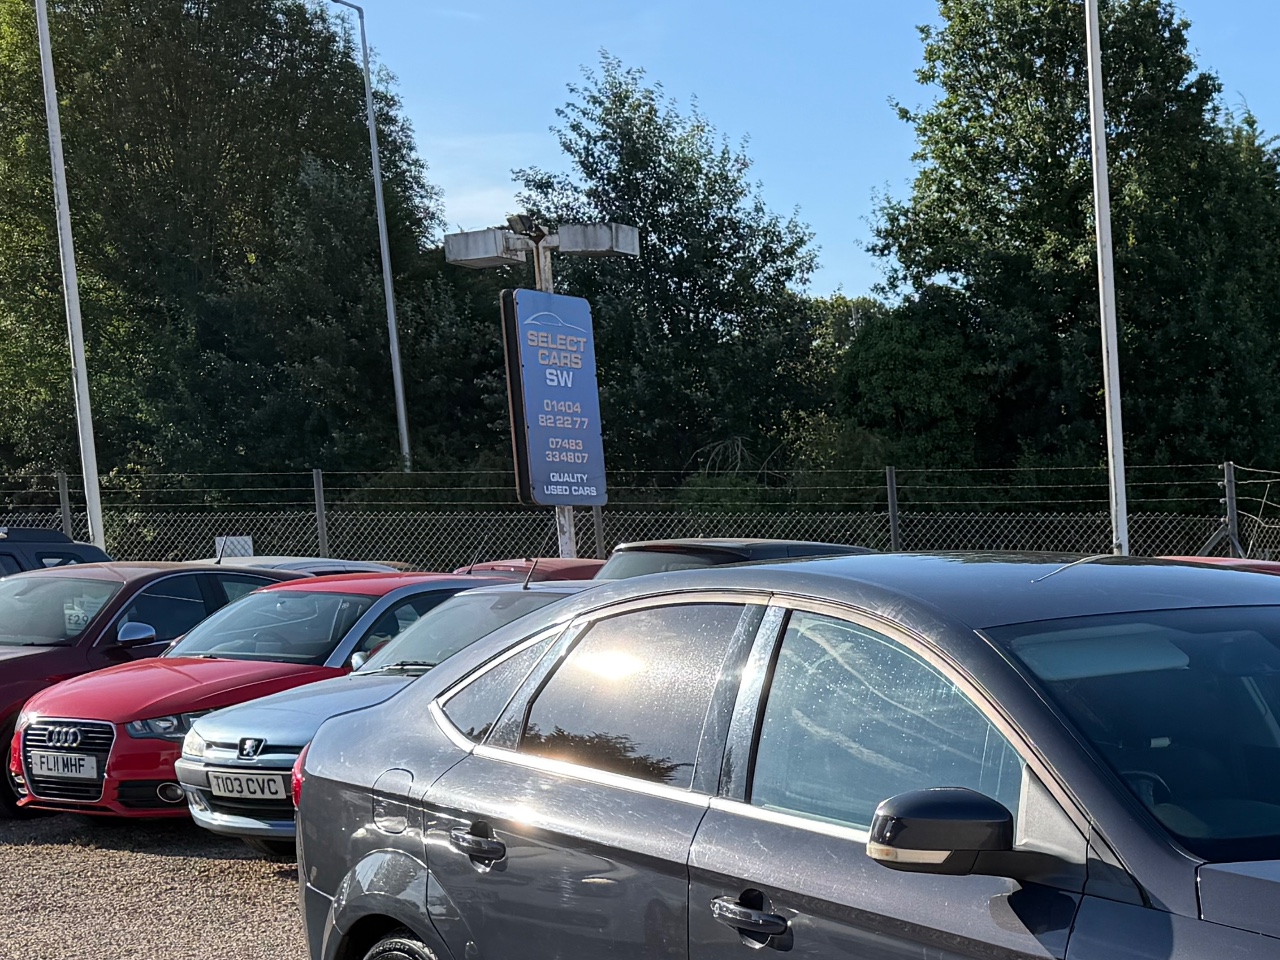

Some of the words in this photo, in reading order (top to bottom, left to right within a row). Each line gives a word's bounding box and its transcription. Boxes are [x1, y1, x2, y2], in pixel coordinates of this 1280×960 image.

[527, 331, 587, 352] SELECT
[538, 350, 583, 369] CARS
[545, 368, 573, 388] SW
[543, 399, 582, 414] 01404
[549, 437, 583, 450] 07483
[545, 451, 589, 463] 334807
[550, 472, 588, 483] QUALITY
[544, 485, 570, 495] USED
[571, 486, 597, 496] CARS
[39, 754, 59, 772] FL11
[62, 757, 86, 774] MHF
[215, 776, 243, 793] T103
[248, 777, 279, 795] CVC
